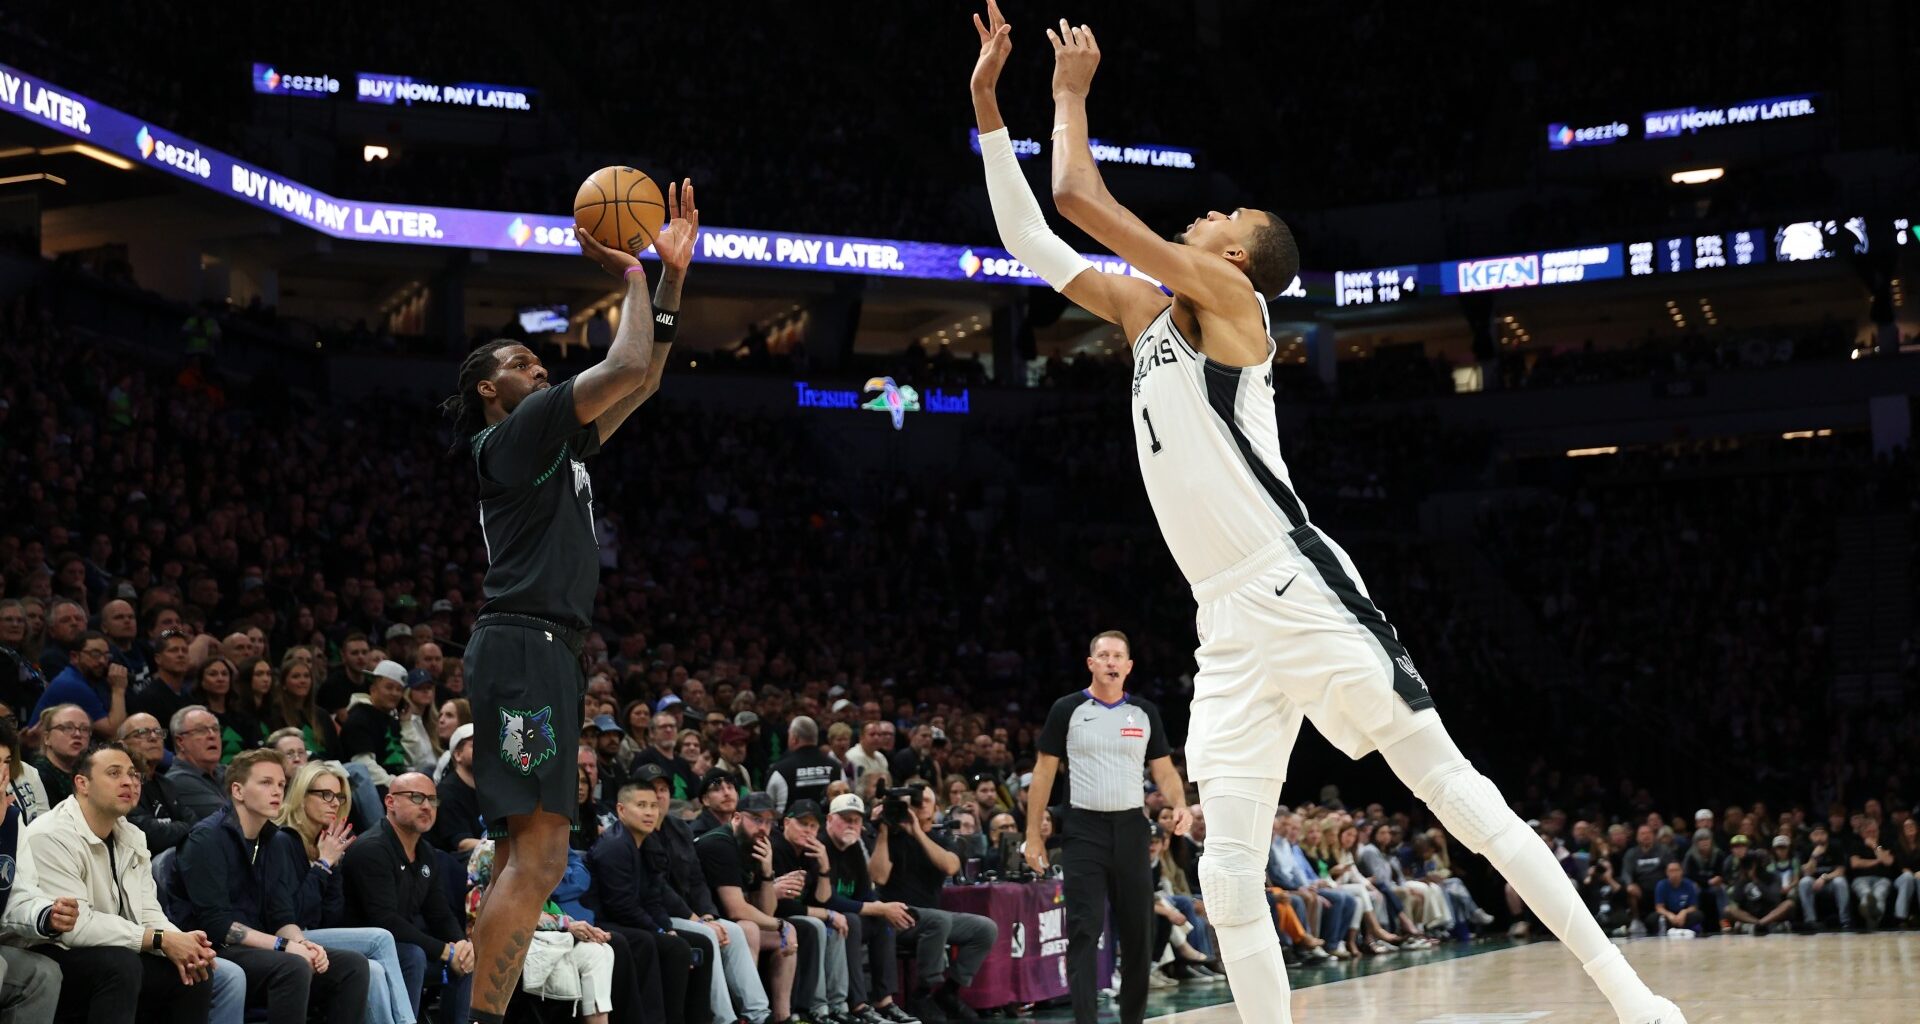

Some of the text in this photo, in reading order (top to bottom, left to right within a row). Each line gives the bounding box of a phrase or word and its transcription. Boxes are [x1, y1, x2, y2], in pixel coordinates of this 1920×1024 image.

[0, 70, 91, 134] AY LATER.
[358, 78, 530, 111] BUY NOW. PAY LATER.
[1575, 121, 1629, 142] sezzle
[1645, 98, 1815, 135] BUY NOW. PAY LATER.
[155, 140, 211, 179] sezzle
[1012, 138, 1041, 155] zzle
[1124, 147, 1150, 166] PAY
[1151, 150, 1196, 169] LATER.
[231, 164, 444, 239] BUY NOW. PAY LATER.
[703, 232, 772, 262] NOW.
[776, 237, 822, 265] PAY
[825, 241, 905, 271] LATER.
[1458, 254, 1540, 293] KFAN
[656, 312, 674, 326] TAYP
[794, 381, 970, 414] Treasure Island
[1142, 407, 1162, 455] 1
[796, 765, 833, 778] BEST
